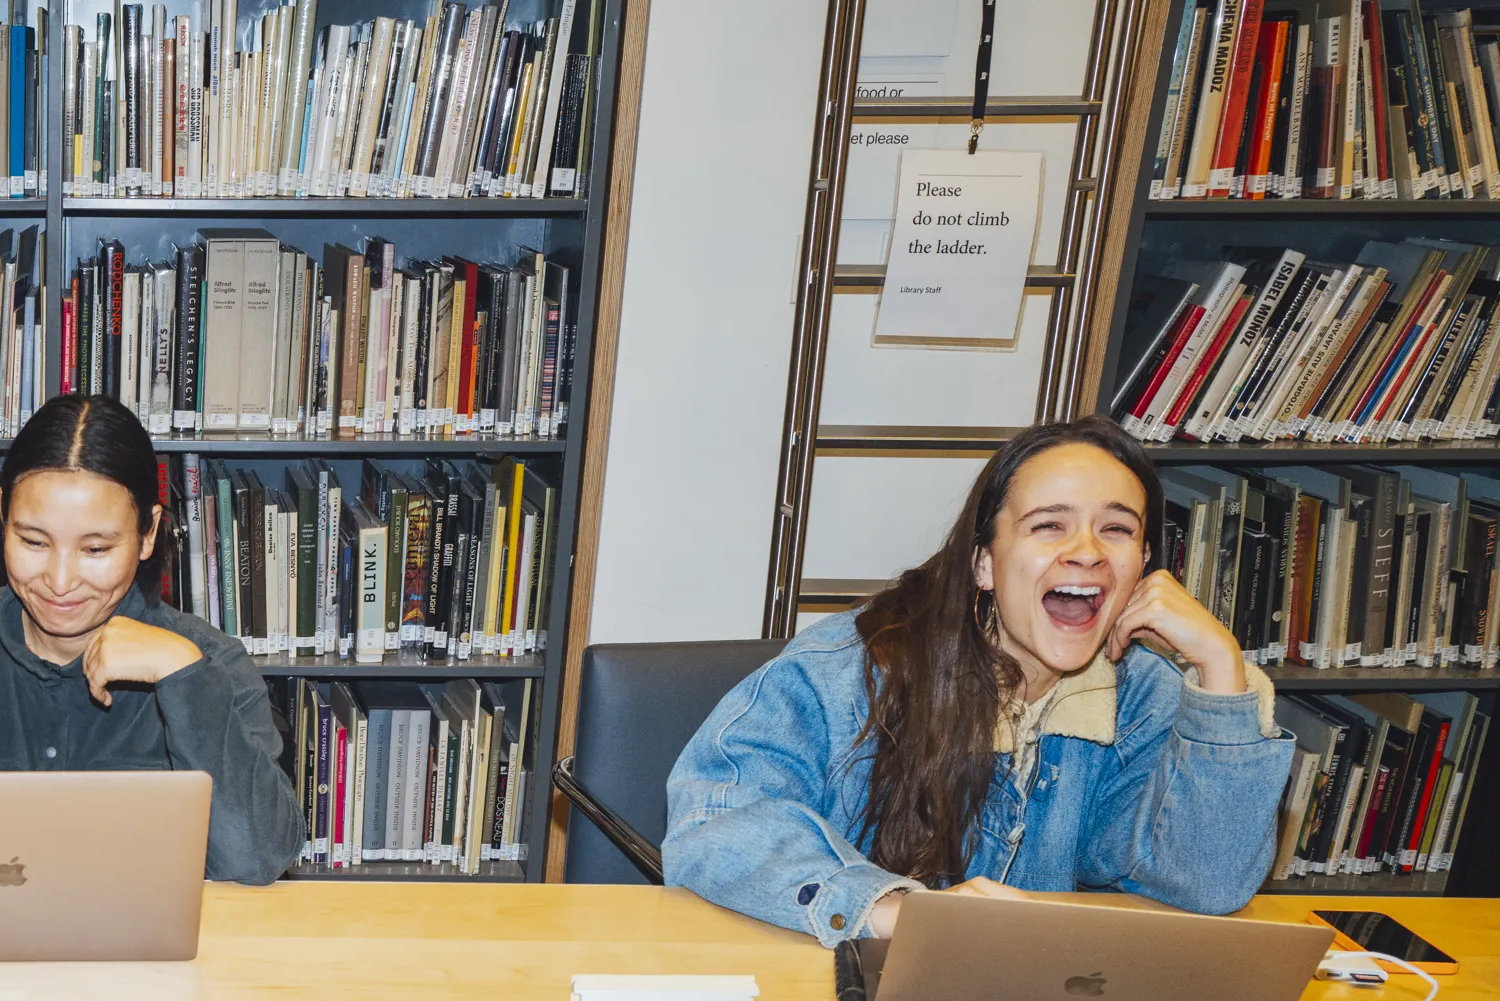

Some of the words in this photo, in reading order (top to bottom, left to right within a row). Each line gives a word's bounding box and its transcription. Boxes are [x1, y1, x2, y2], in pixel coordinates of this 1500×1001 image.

[1219, 0, 1238, 44] CHEMA
[1210, 46, 1230, 94] MADOZ
[1298, 51, 1306, 73] ANN
[191, 87, 201, 100] SID
[857, 86, 887, 98] food
[891, 90, 904, 98] or
[190, 101, 200, 143] GROSSMAN
[1290, 76, 1304, 145] MANDELBAUM
[1423, 84, 1435, 126] SUMMER'S
[1431, 126, 1439, 144] DAY
[866, 132, 909, 148] please
[916, 182, 962, 198] Please
[912, 211, 933, 227] do
[936, 214, 962, 227] not
[966, 211, 1010, 228] climb
[908, 240, 932, 256] the
[936, 240, 987, 257] ladder.
[111, 251, 123, 336] RODCHENKO
[900, 286, 924, 296] Library
[925, 286, 942, 295] Staff
[1210, 276, 1235, 312] Photography
[1263, 261, 1296, 302] ISABEL
[187, 266, 198, 345] STEICHEN'S
[1206, 312, 1215, 321] at
[1195, 320, 1211, 339] MoMA
[1239, 304, 1272, 347] MUÑOZ
[1442, 312, 1468, 350] DREAM
[158, 328, 168, 374] NELLY'S
[1311, 349, 1326, 368] AUS
[1323, 321, 1343, 350] JAPAN
[184, 352, 194, 403] LEGACY
[1428, 353, 1450, 377] LIFE
[436, 507, 444, 522] BILL
[434, 523, 443, 553] BRANDT:
[534, 516, 544, 556] STRANGE
[239, 540, 251, 586] BEATON
[468, 534, 478, 570] SEASONS
[1254, 545, 1263, 570] SAMARAS
[1278, 548, 1289, 578] MARIAN
[1372, 528, 1394, 599] SIEFF
[363, 543, 377, 603] BLINK.
[431, 552, 440, 583] SHADOW
[468, 570, 475, 581] OF
[531, 558, 540, 589] RITUAL
[430, 583, 438, 594] OF
[465, 582, 474, 607] LIGHT
[429, 594, 437, 615] LIGHT
[321, 718, 329, 736] bruce
[359, 726, 367, 742] Bruce
[319, 737, 327, 762] cratsley
[357, 743, 365, 768] Davidson
[375, 746, 383, 778] DAVIDSON
[395, 746, 403, 778] DAVIDSON
[414, 746, 422, 778] DAVIDSON
[393, 782, 401, 810] OUTSIDE
[412, 782, 420, 810] OUTSIDE
